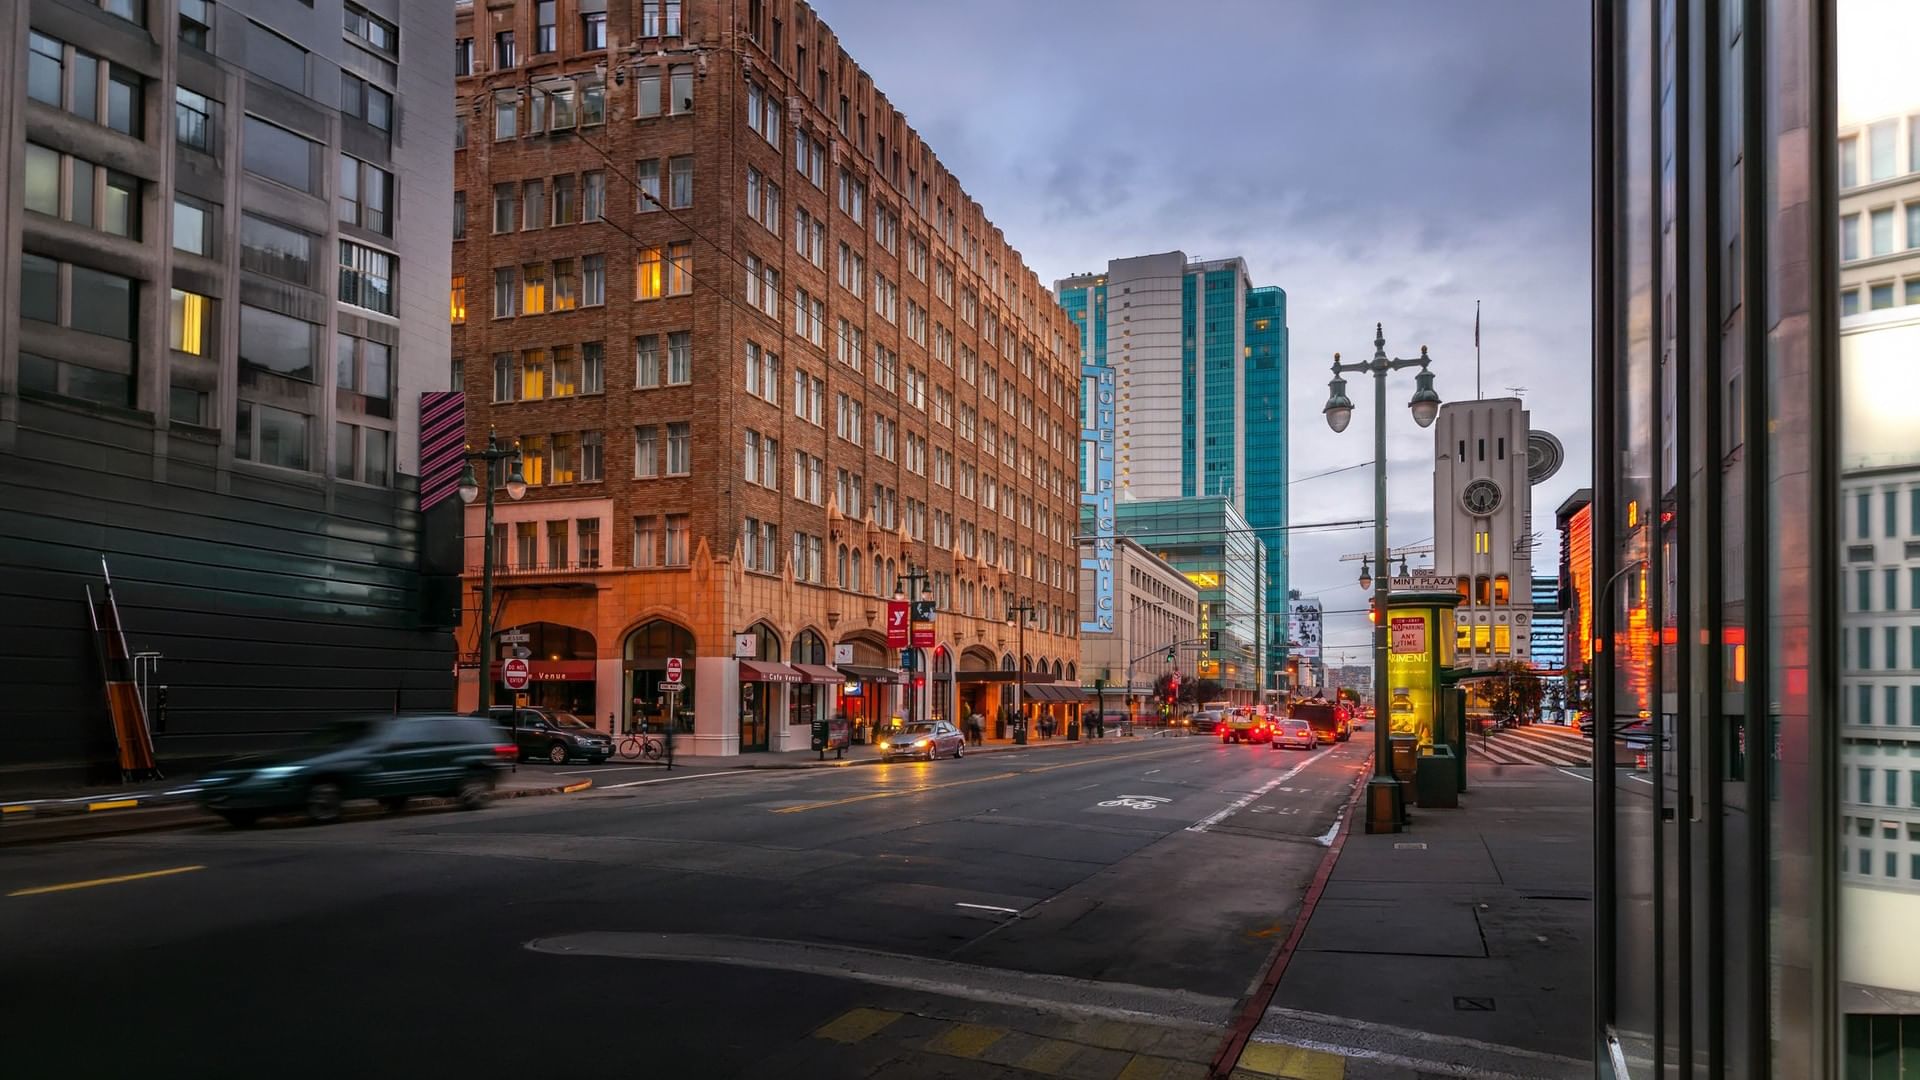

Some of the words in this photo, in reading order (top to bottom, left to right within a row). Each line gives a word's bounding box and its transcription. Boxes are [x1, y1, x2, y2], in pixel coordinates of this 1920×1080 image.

[1099, 370, 1114, 462] HOTEL
[1098, 478, 1114, 631] PICKWICK
[1201, 603, 1209, 668] PARKNG
[538, 672, 567, 680] Venue
[769, 673, 783, 681] Cafe
